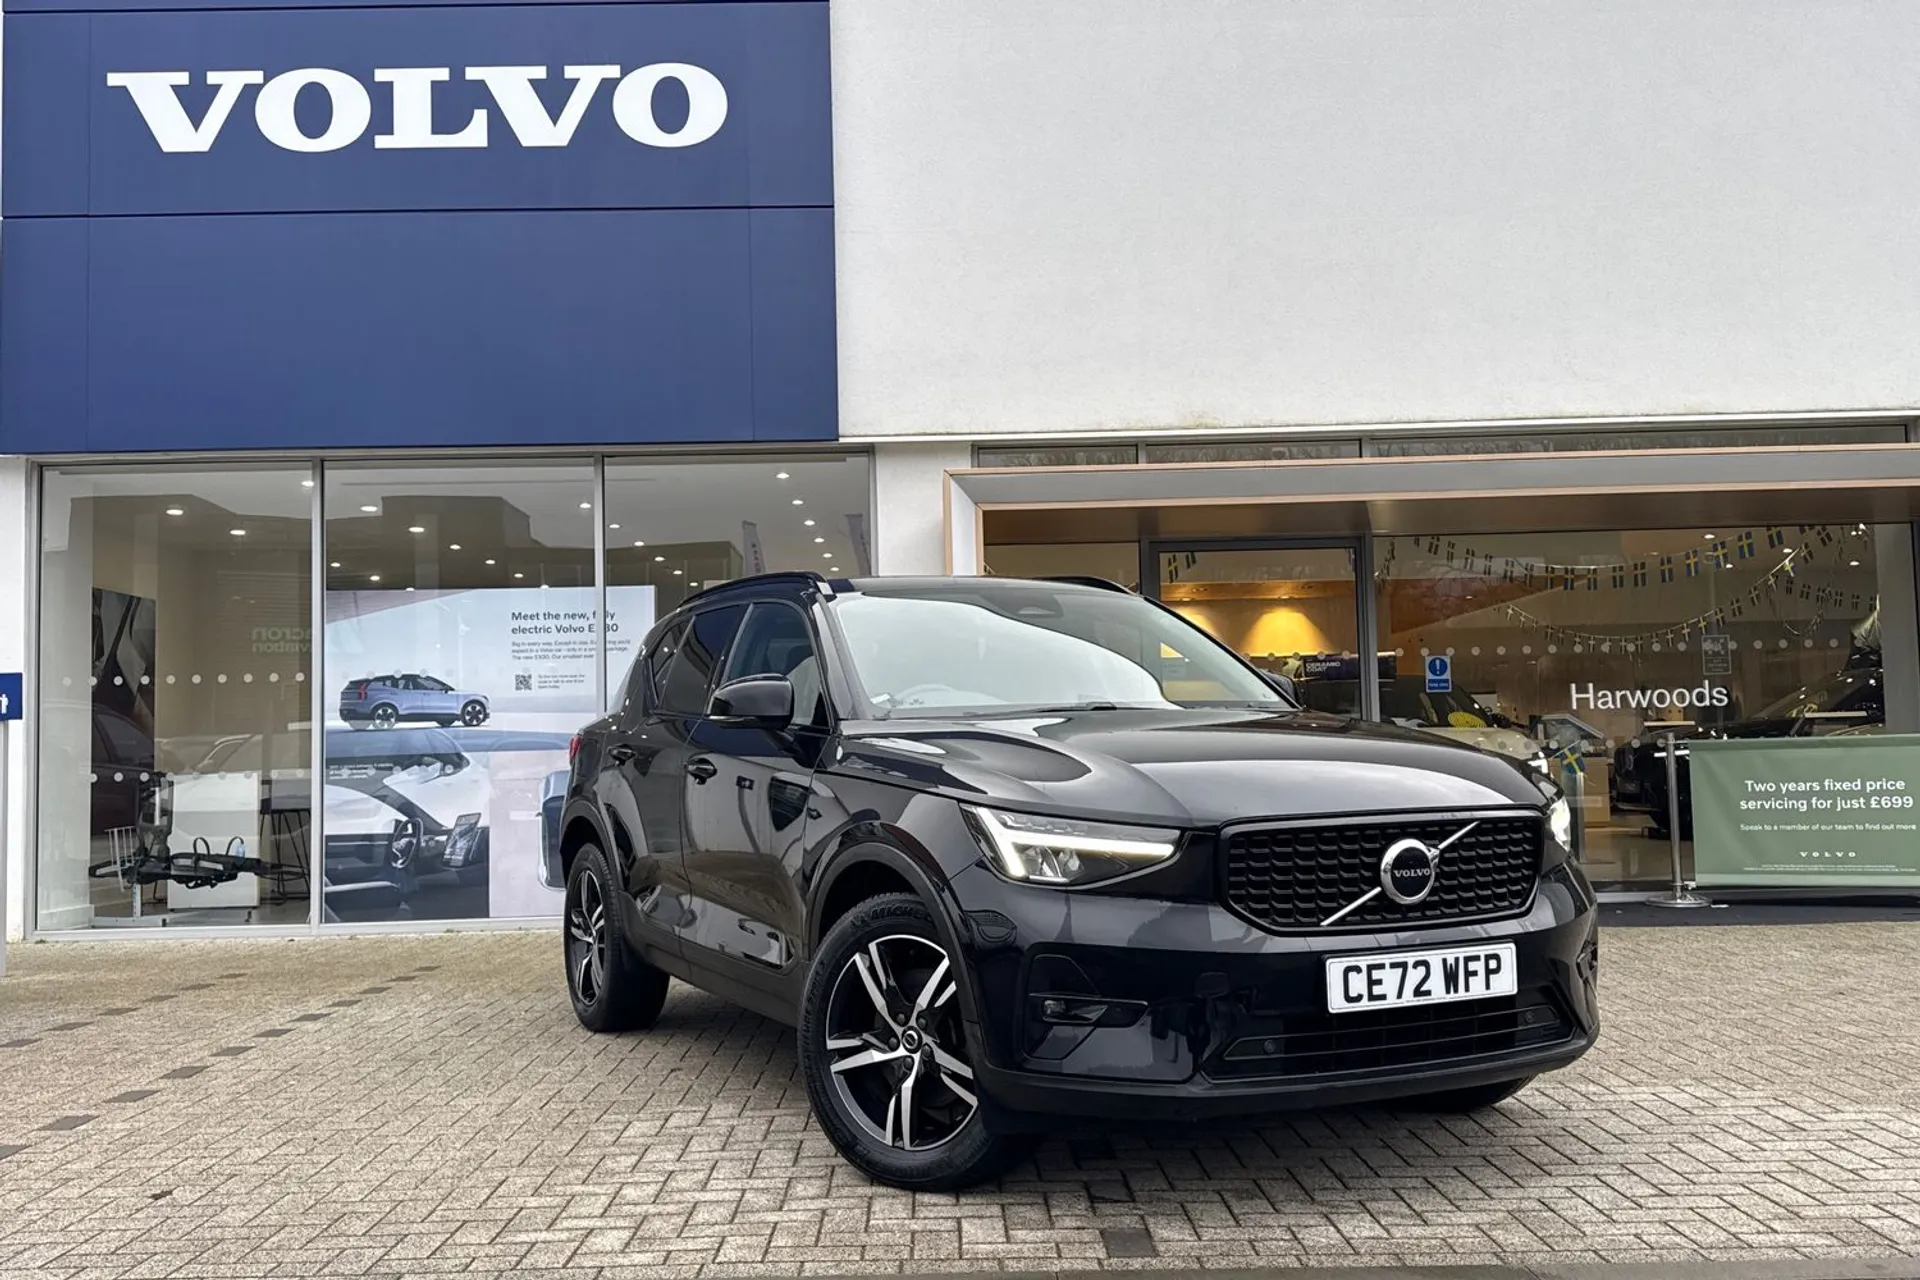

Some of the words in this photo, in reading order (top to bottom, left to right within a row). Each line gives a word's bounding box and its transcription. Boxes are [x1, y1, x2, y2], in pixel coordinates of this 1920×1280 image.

[107, 62, 729, 154] VOLVO
[511, 611, 540, 621] Meet
[543, 611, 561, 620] the
[564, 612, 589, 621] new,
[592, 610, 616, 621] fly
[511, 624, 552, 634] electric
[555, 624, 585, 634] Volvo
[588, 623, 619, 633] E30
[1569, 679, 1729, 710] Harwoods
[1744, 780, 1776, 792] Two
[1779, 781, 1821, 794] years
[1823, 778, 1861, 791] fixed
[1866, 778, 1906, 793] price
[1739, 797, 1808, 812] servicing
[1811, 796, 1833, 809] for
[1836, 796, 1866, 811] just
[1870, 795, 1914, 809] £699
[1779, 823, 1810, 831] member
[1811, 823, 1819, 831] of
[1394, 867, 1431, 878] VOLVO
[871, 904, 930, 921] MICHE
[1343, 959, 1432, 1004] CE72
[1441, 953, 1502, 995] WFP
